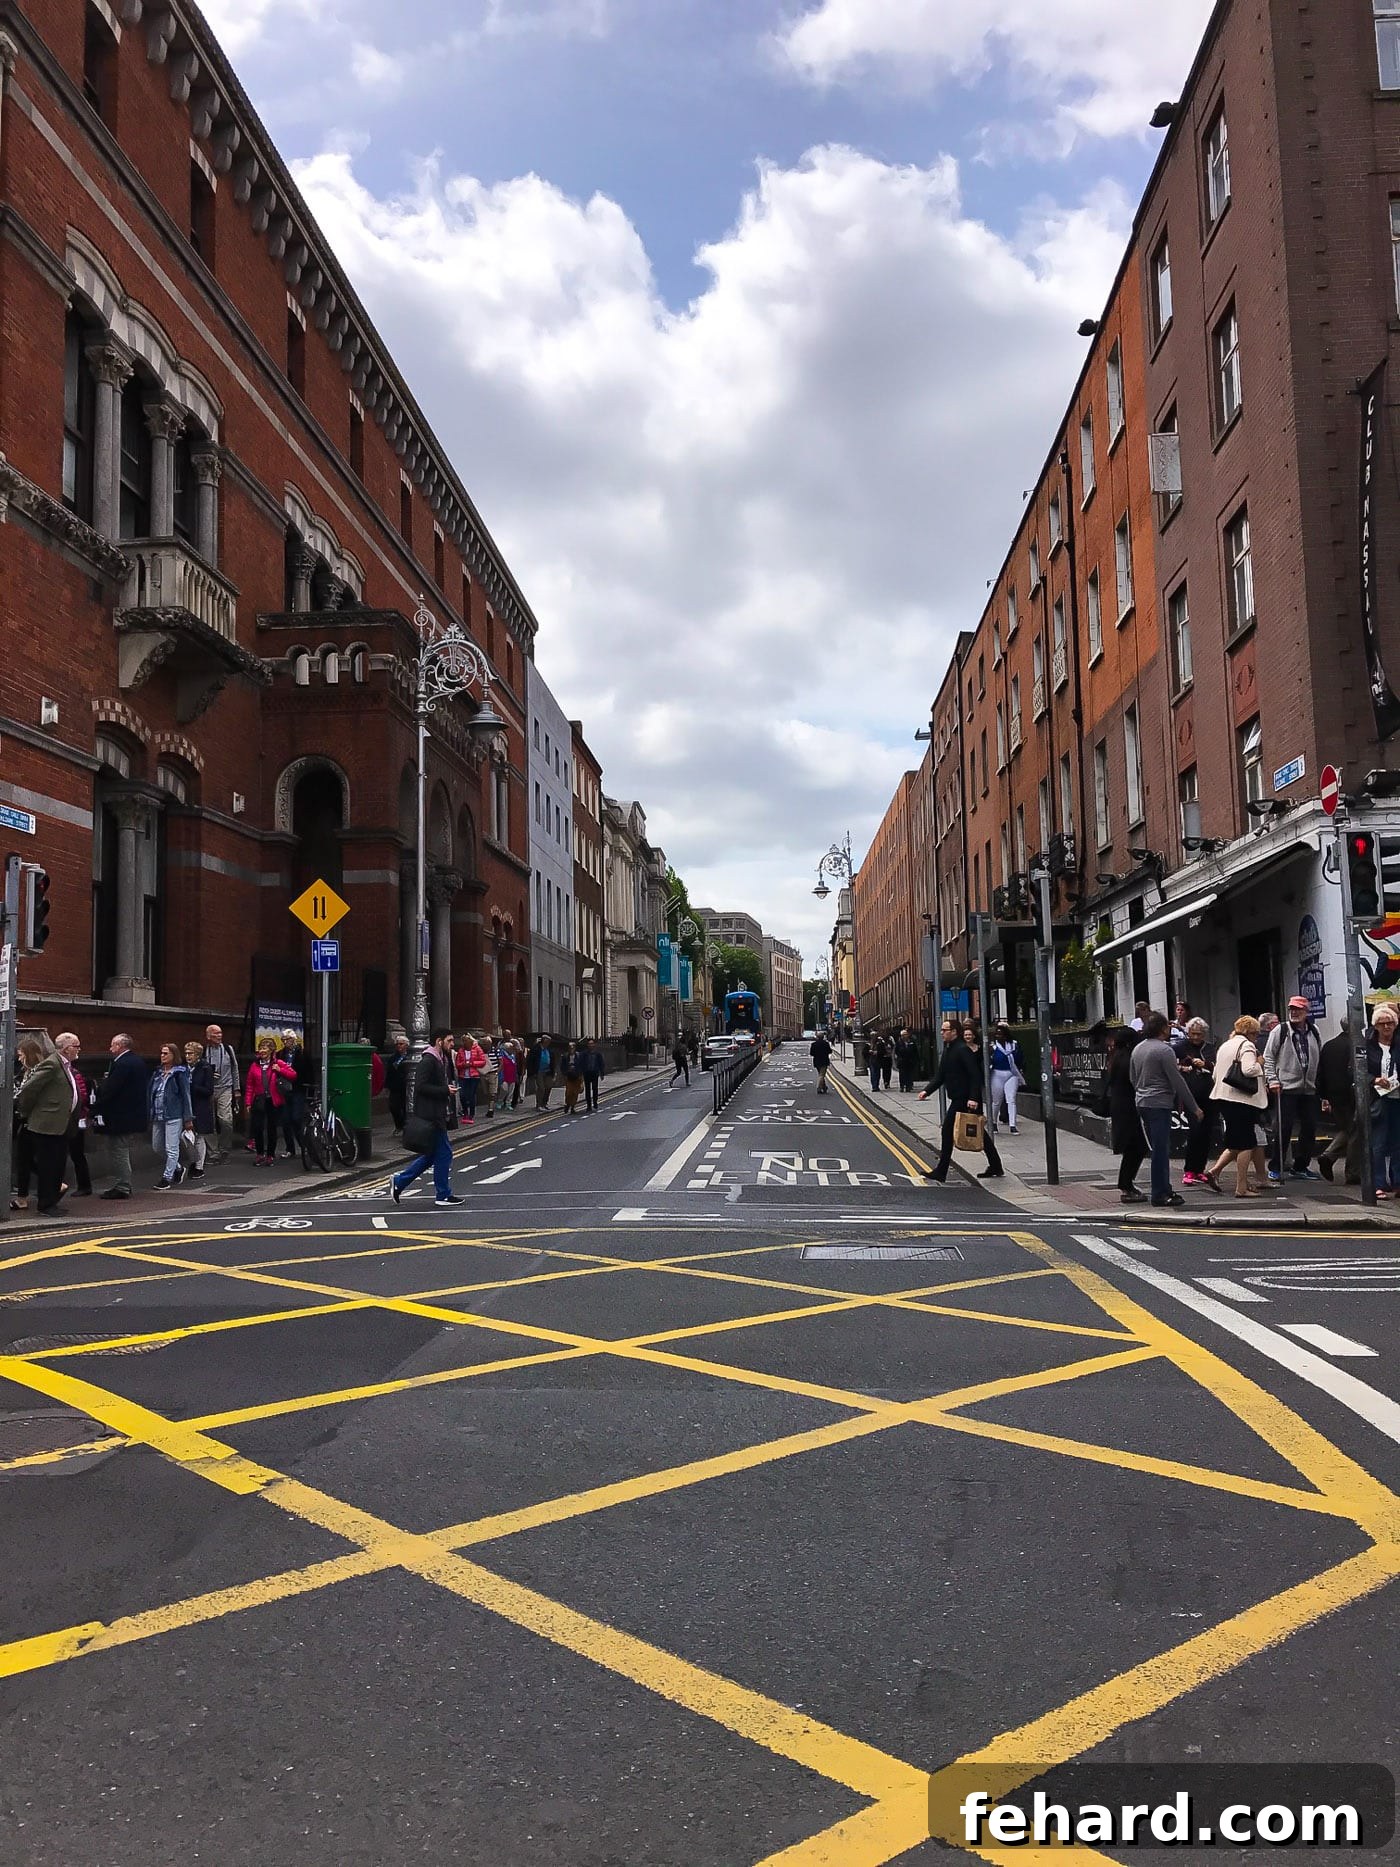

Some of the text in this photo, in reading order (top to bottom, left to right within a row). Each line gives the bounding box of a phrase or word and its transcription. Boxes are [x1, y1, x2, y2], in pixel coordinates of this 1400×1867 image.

[1363, 395, 1375, 635] CLUB NASSAU
[760, 1156, 850, 1171] NO
[709, 1171, 926, 1187] ENTRY
